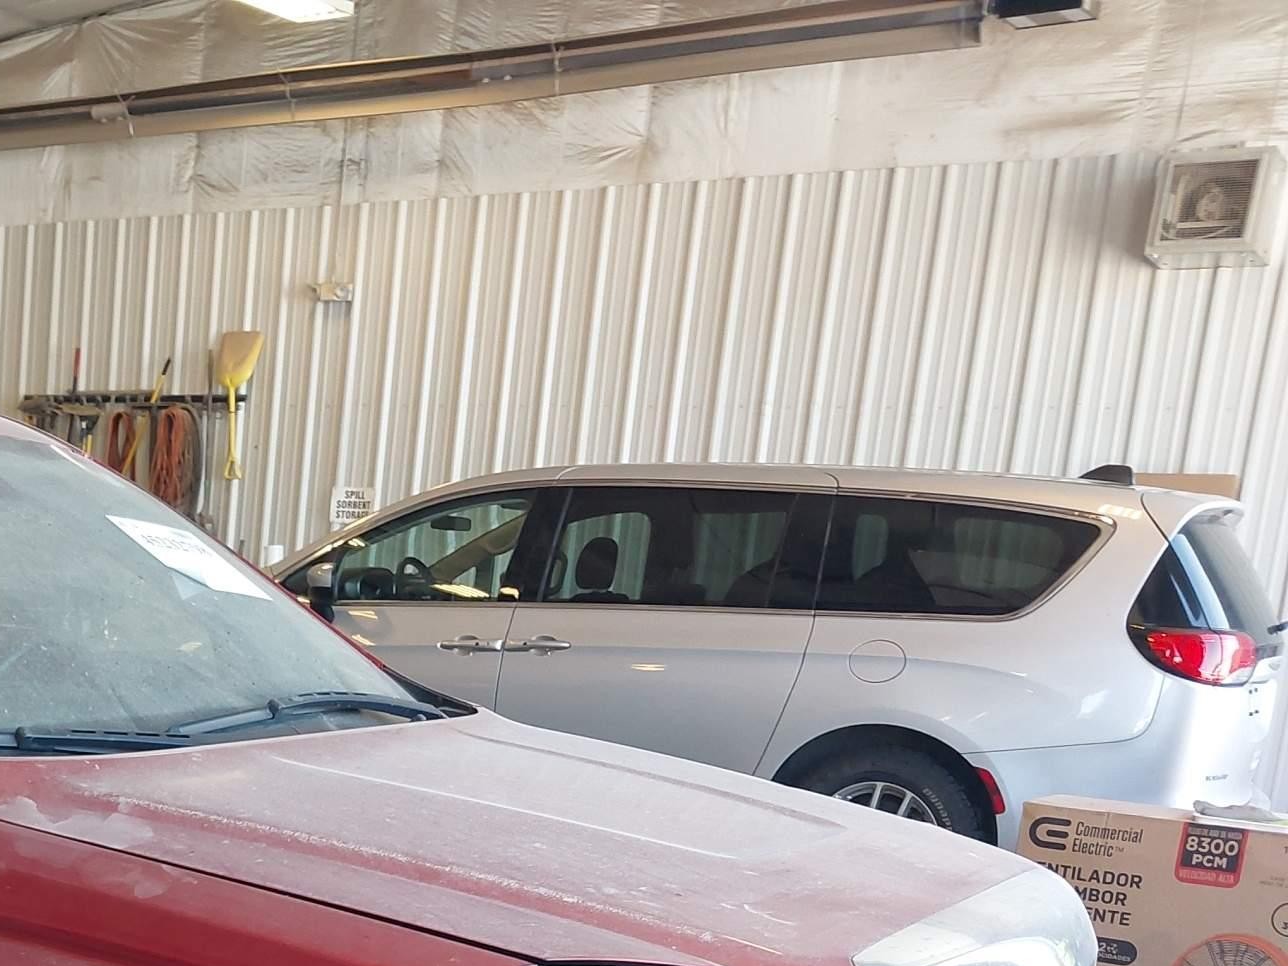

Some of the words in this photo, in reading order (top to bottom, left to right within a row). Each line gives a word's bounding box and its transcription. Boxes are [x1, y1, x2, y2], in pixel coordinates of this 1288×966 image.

[344, 490, 365, 500] SPILL
[336, 500, 372, 510] SORBENT
[1075, 821, 1144, 844] Commercial
[1185, 835, 1239, 857] 8300
[1191, 853, 1228, 870] PCM
